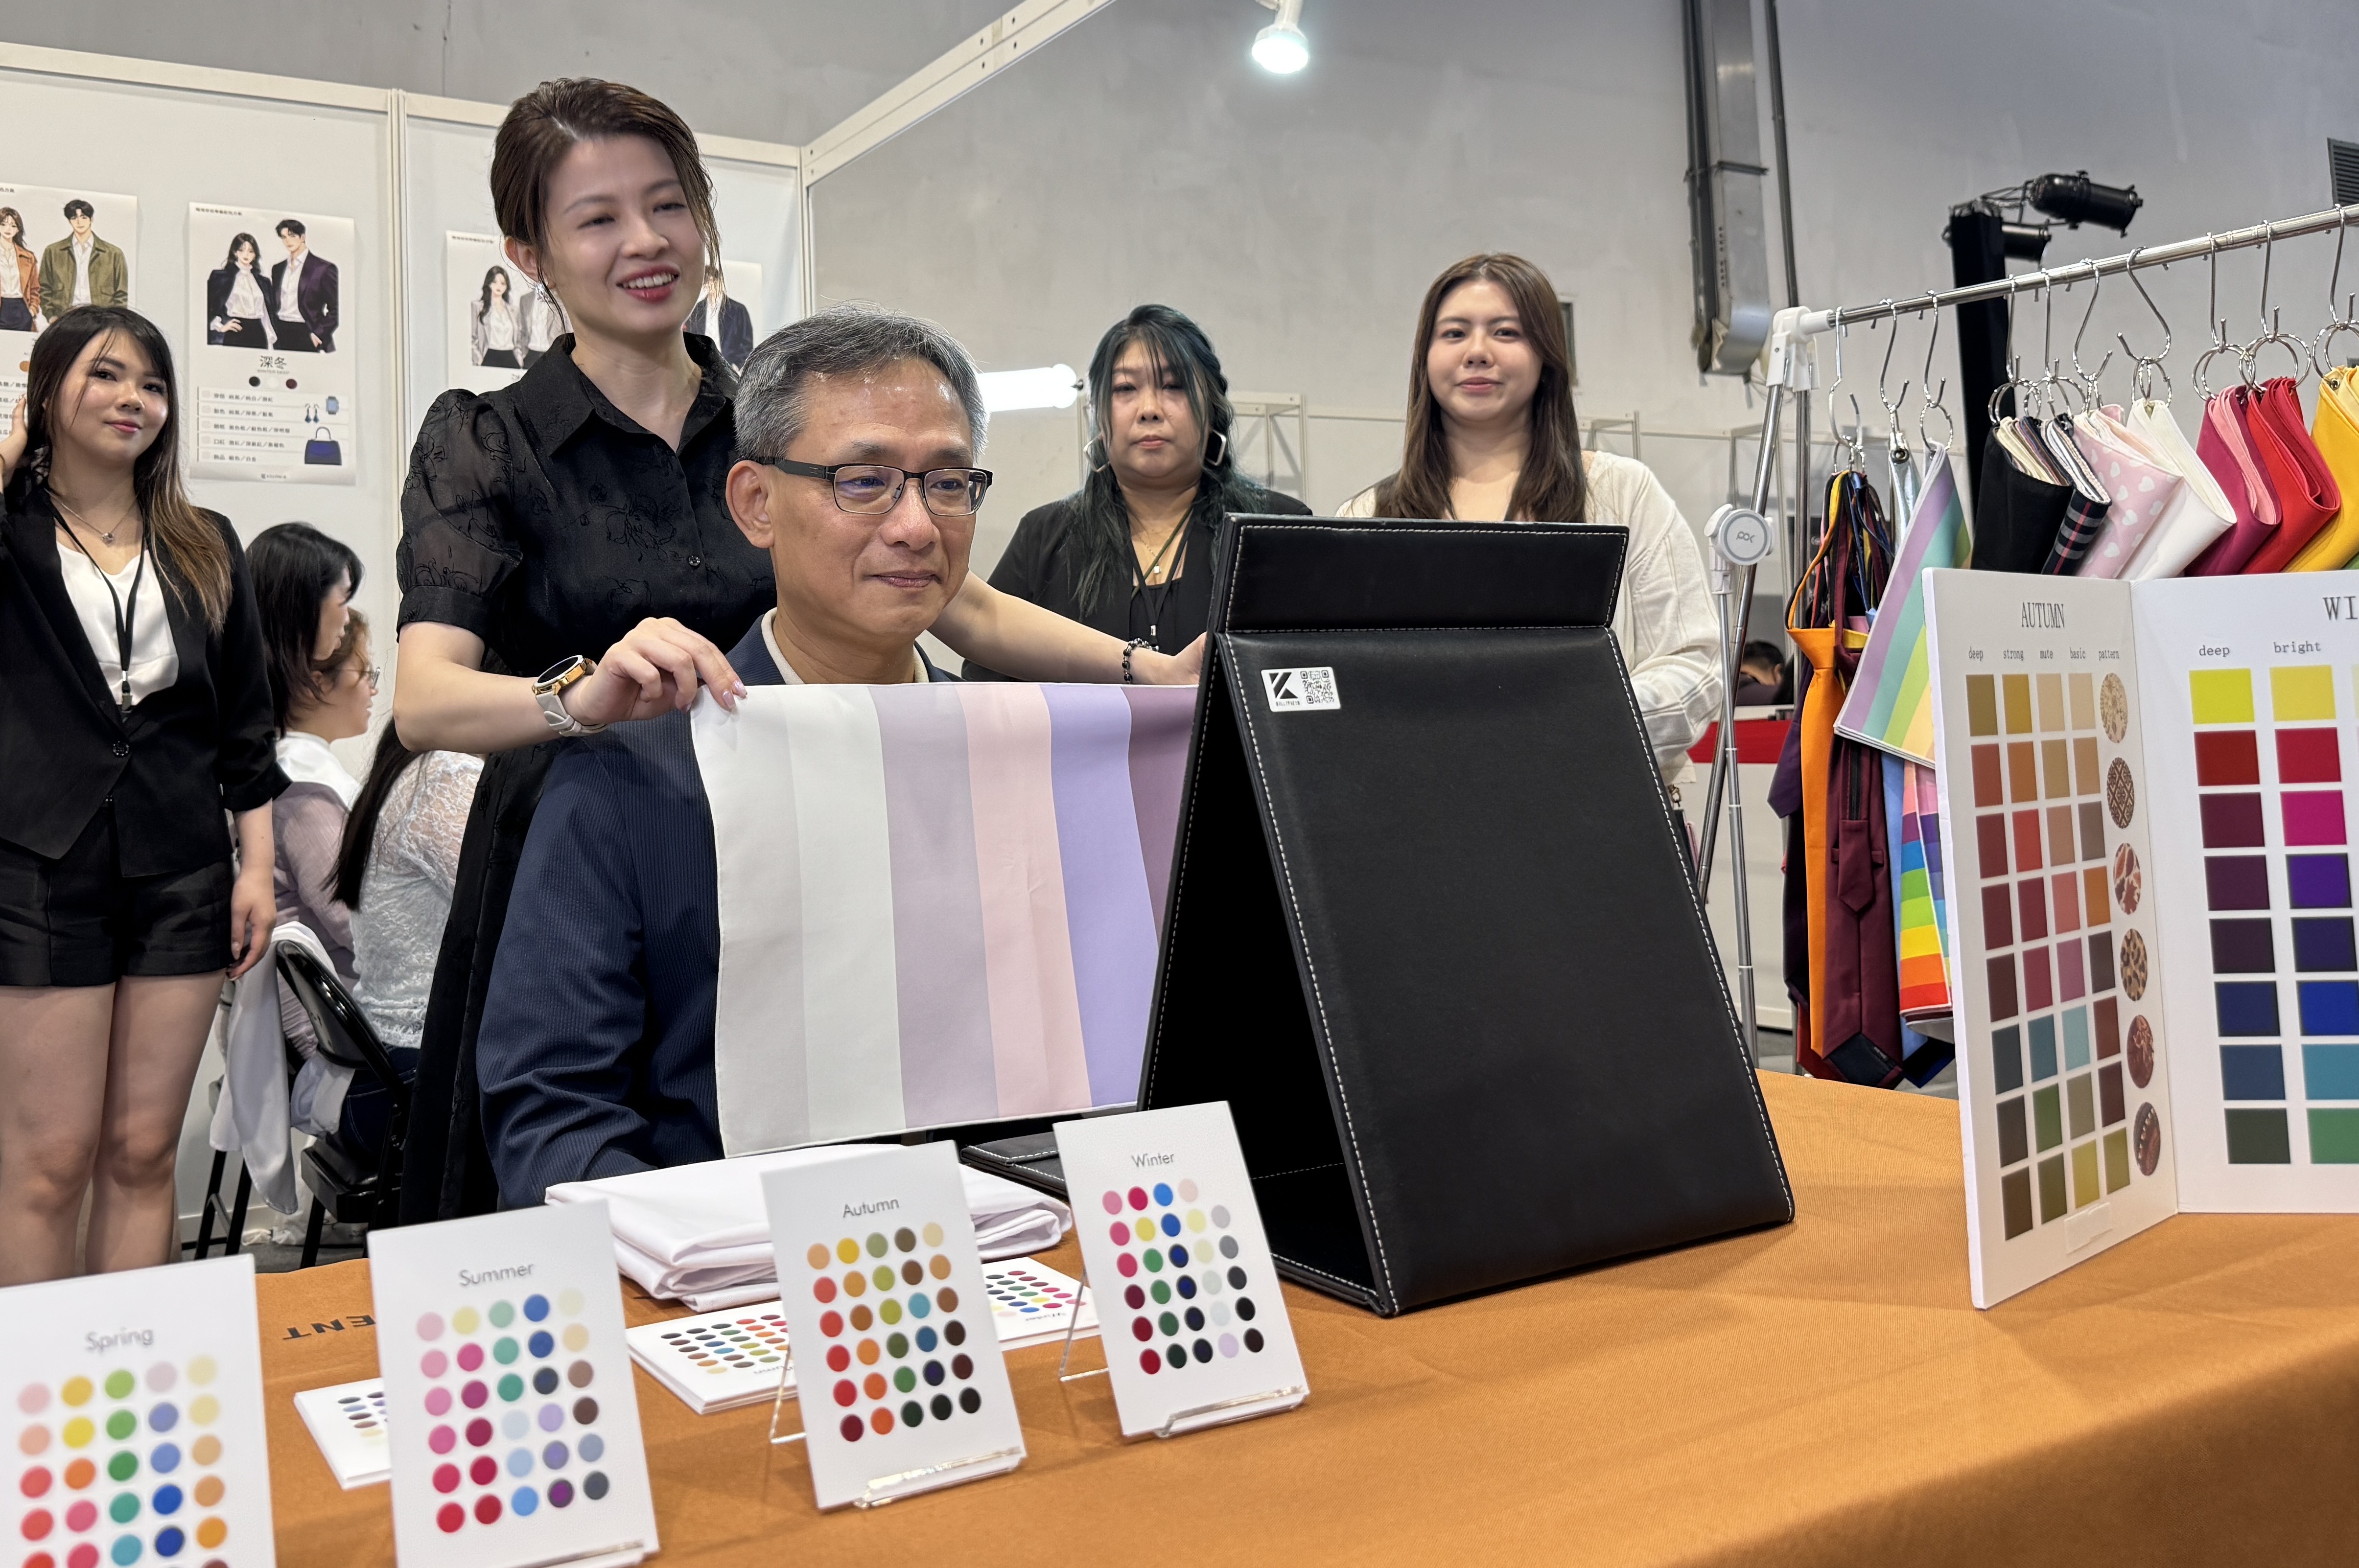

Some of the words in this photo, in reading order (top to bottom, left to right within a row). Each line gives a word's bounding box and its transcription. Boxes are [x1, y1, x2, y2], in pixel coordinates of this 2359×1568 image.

[260, 355, 287, 369] 深冬
[2021, 602, 2065, 628] AUTUMN
[1968, 646, 1984, 661] deep
[2003, 649, 2024, 661] strong
[2040, 649, 2053, 659] mute
[2070, 647, 2085, 659] basic
[2099, 650, 2119, 661] pattern
[2199, 645, 2230, 657] deep
[2273, 641, 2321, 654] bright
[1131, 1153, 1174, 1167] Winter
[843, 1199, 900, 1218] Autumn
[459, 1264, 534, 1287] Summer
[86, 1327, 154, 1353] Spring
